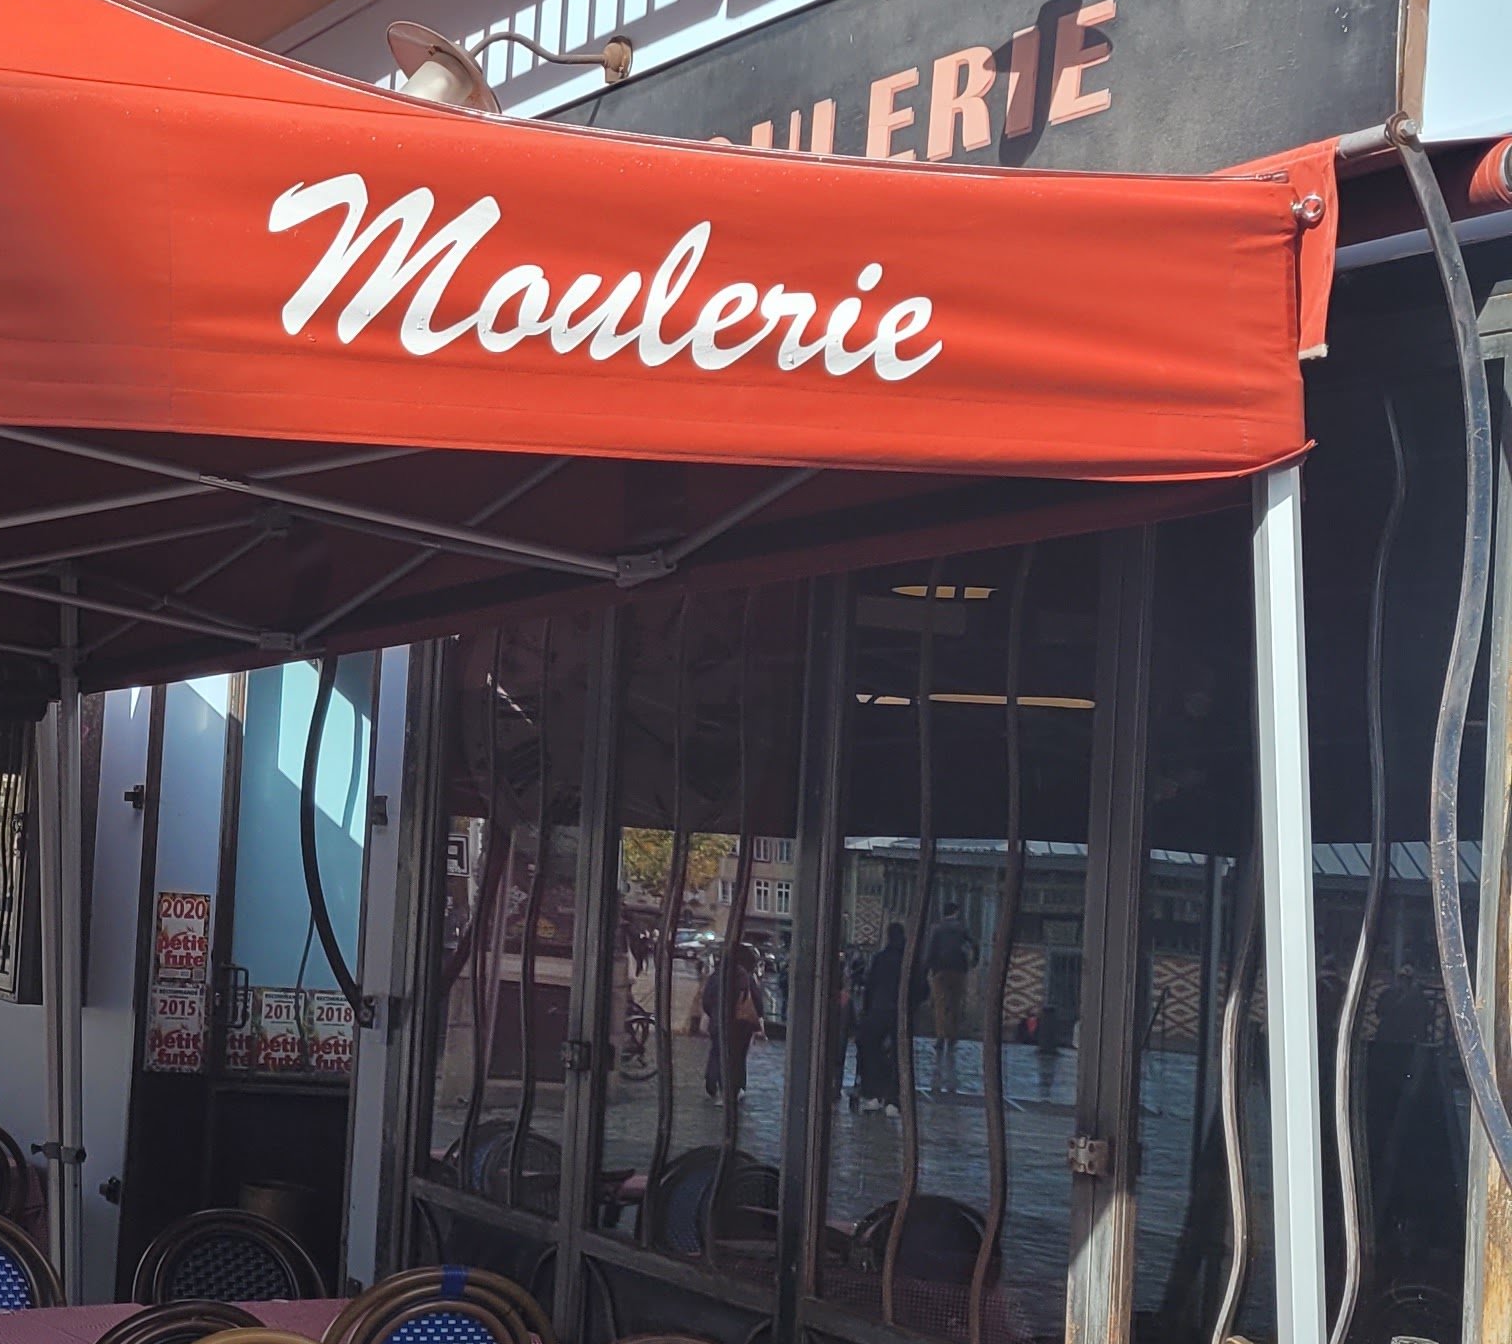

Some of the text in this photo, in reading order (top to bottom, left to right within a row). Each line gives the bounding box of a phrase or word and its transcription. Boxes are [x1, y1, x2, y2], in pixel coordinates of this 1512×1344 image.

[267, 172, 944, 382] Moulerie
[161, 898, 207, 920] 2020
[156, 932, 208, 954] petit
[158, 999, 197, 1017] 2015
[264, 1003, 301, 1021] 201
[316, 1006, 353, 1023] 2018
